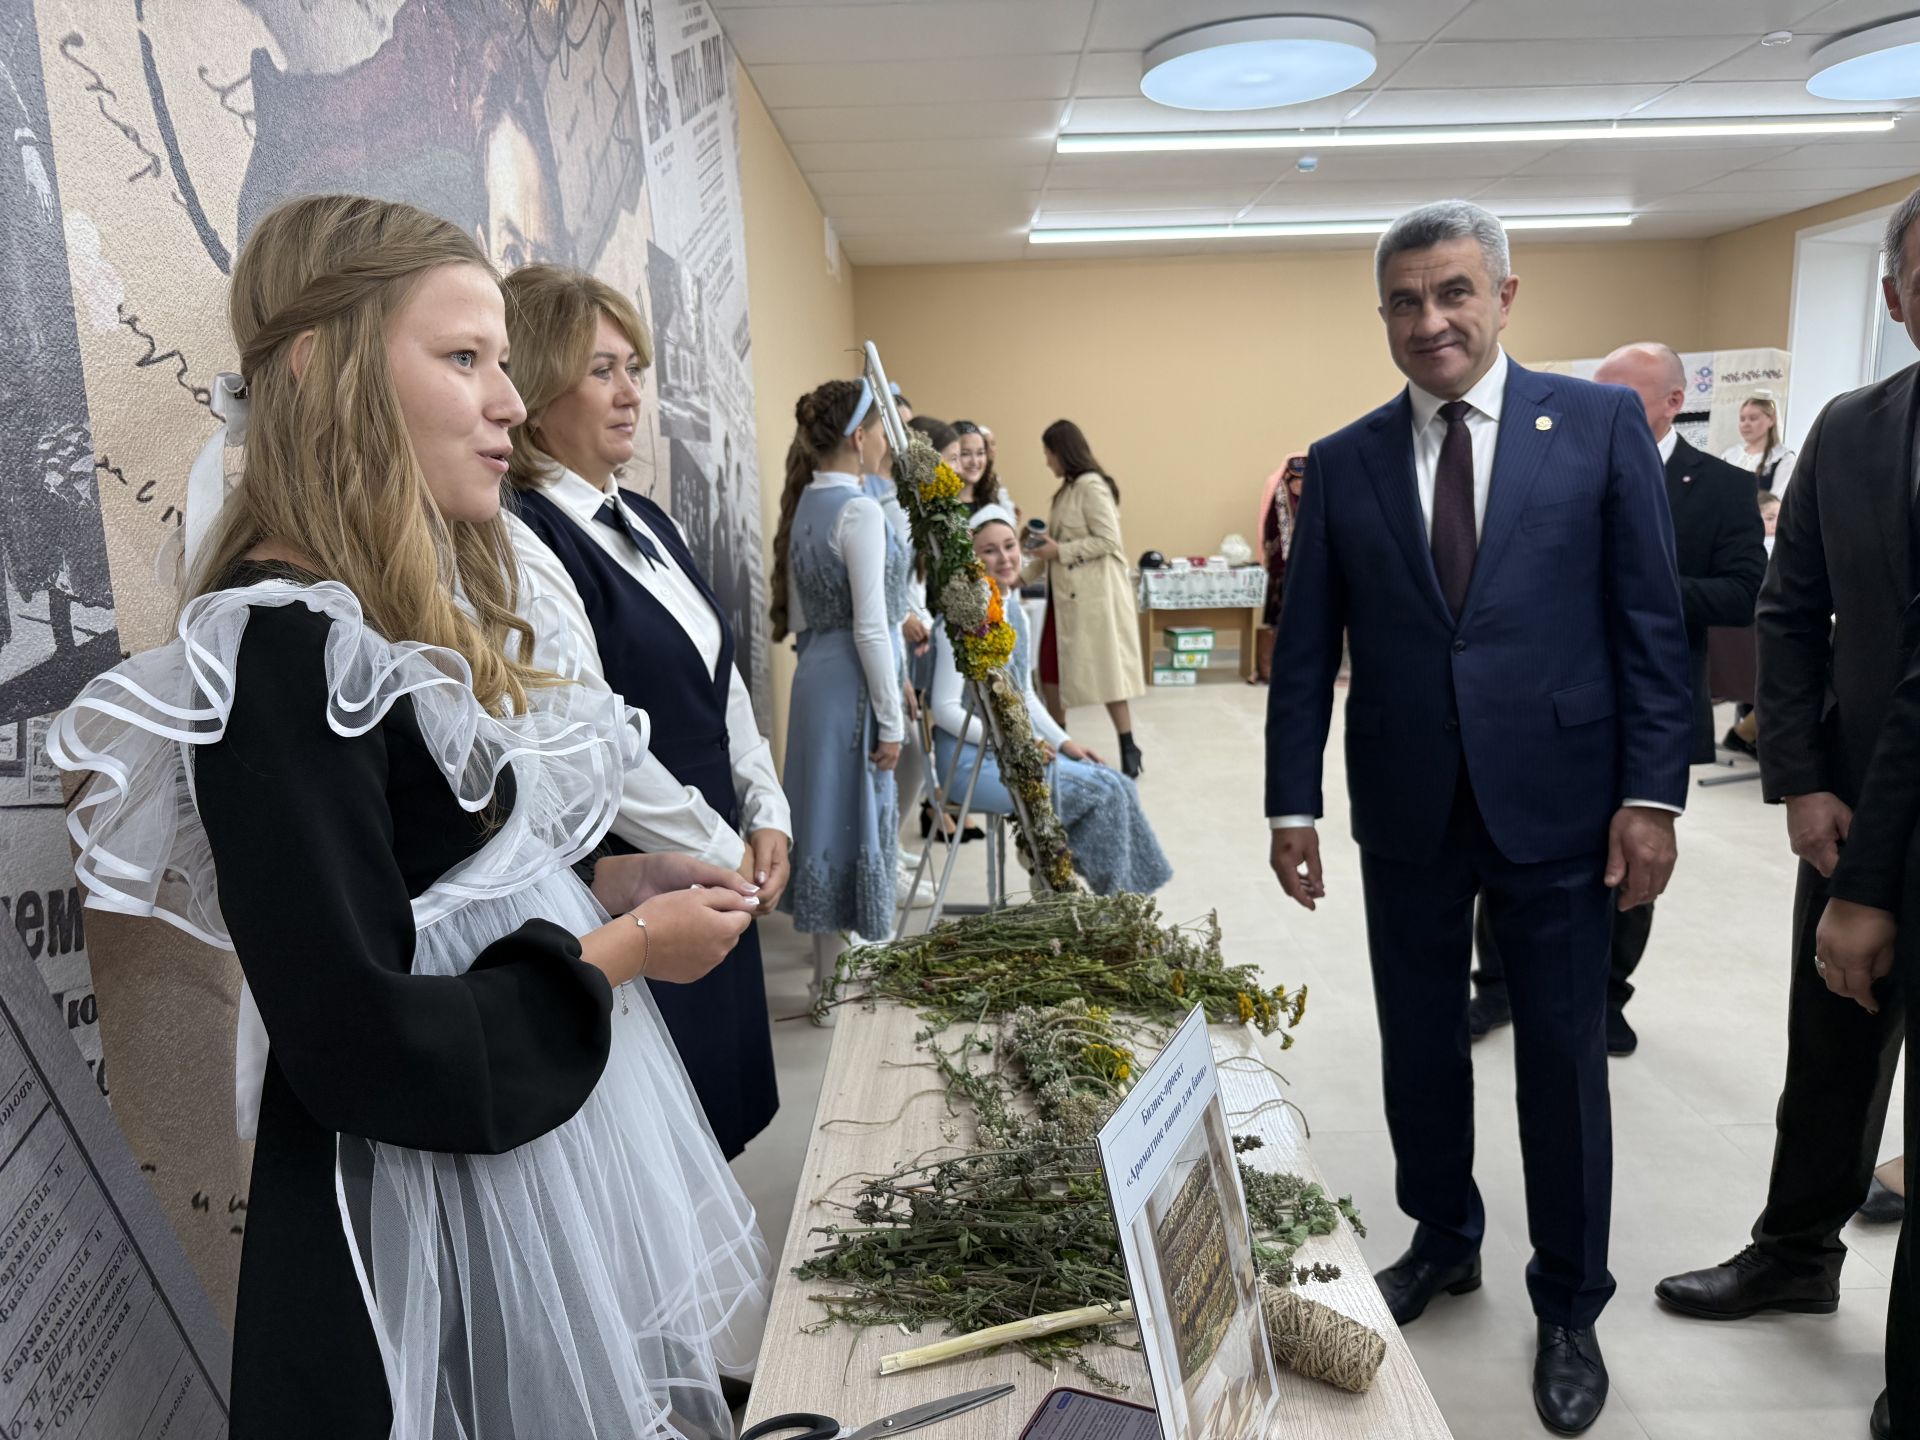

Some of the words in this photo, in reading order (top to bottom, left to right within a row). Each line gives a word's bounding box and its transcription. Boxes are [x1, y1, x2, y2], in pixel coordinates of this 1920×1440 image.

[1126, 1128, 1164, 1188] «Ароматное
[1164, 1101, 1182, 1134] панно
[1181, 1086, 1193, 1109] для
[1191, 1064, 1207, 1093] бани»
[1141, 1062, 1184, 1127] Бизнес-проект
[2, 1247, 91, 1386] Фармакогнозія
[32, 1279, 92, 1366] Фармація.
[54, 1302, 132, 1428] Органическая
[82, 1350, 121, 1410] Химія.
